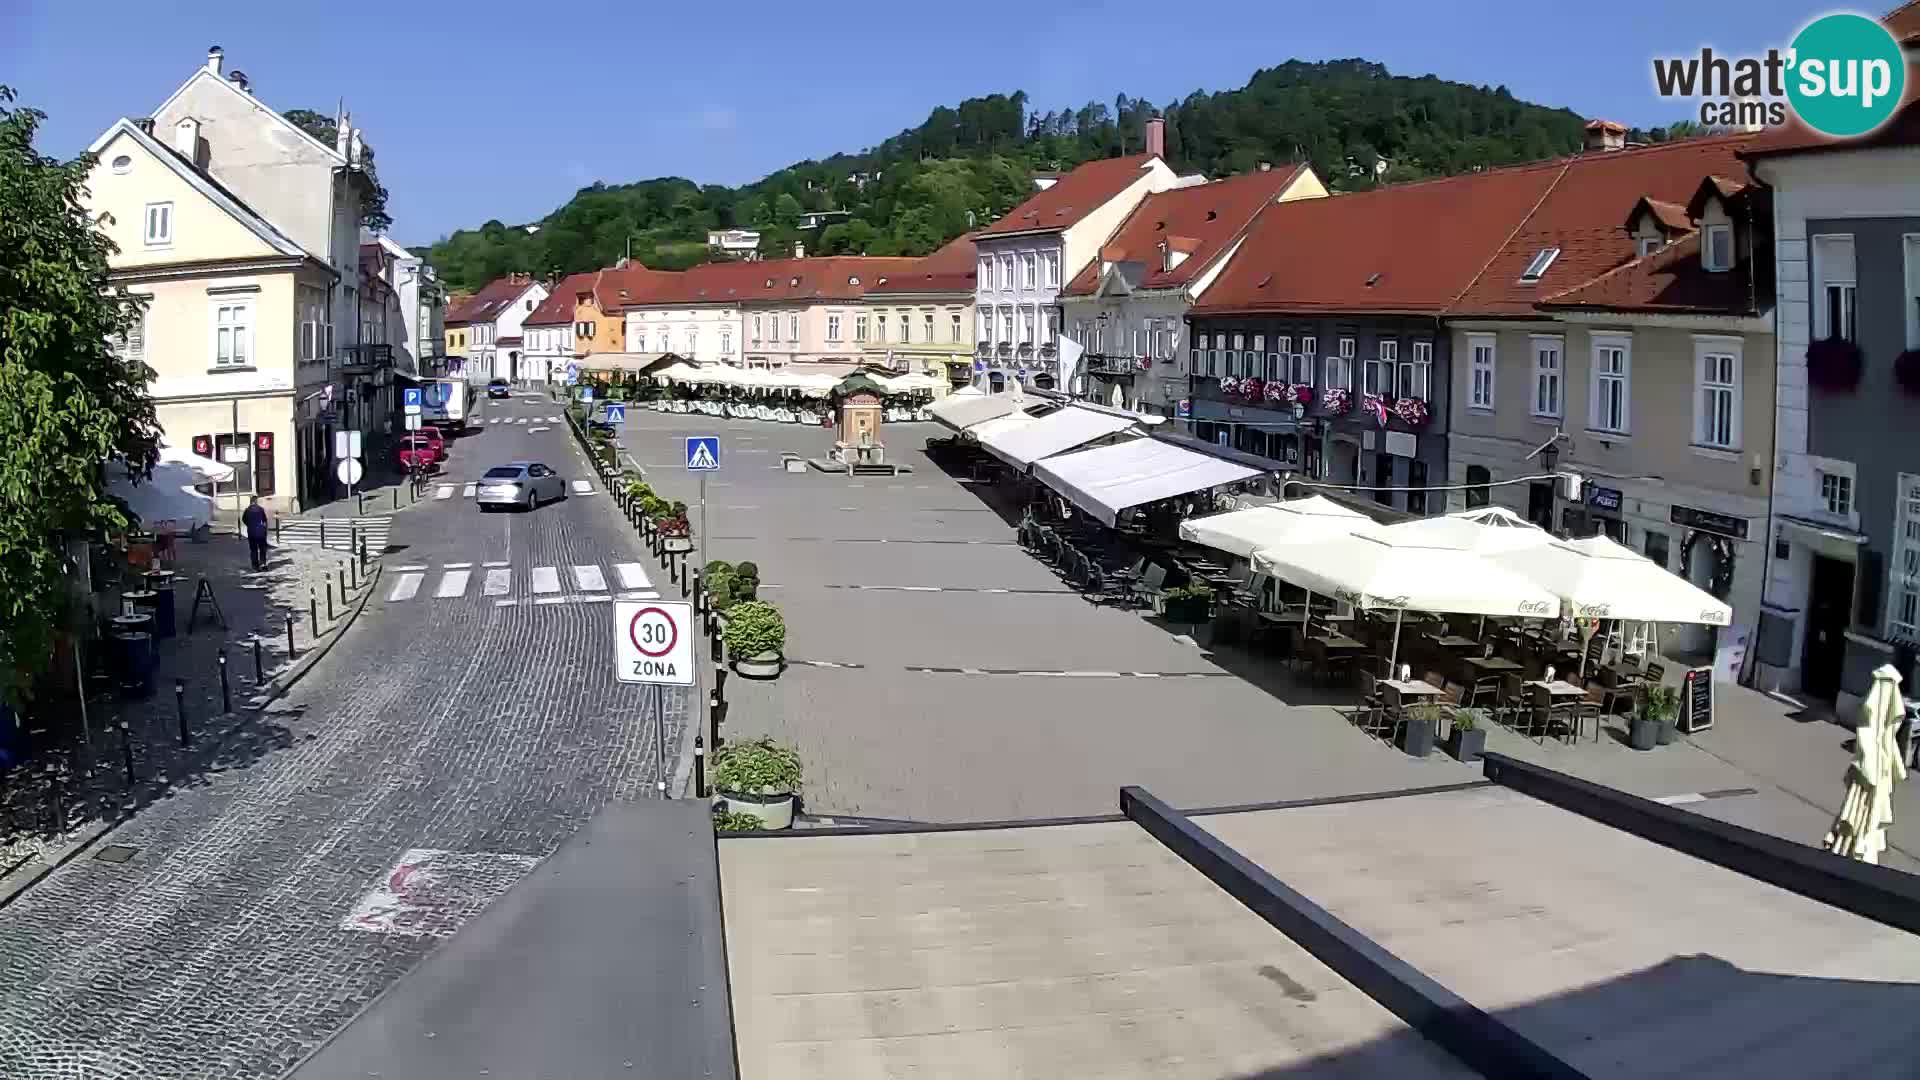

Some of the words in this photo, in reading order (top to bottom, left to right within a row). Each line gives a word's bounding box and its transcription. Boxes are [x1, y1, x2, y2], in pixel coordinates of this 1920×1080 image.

[408, 391, 417, 402] P
[642, 623, 666, 644] 30
[632, 660, 677, 677] ZONA
